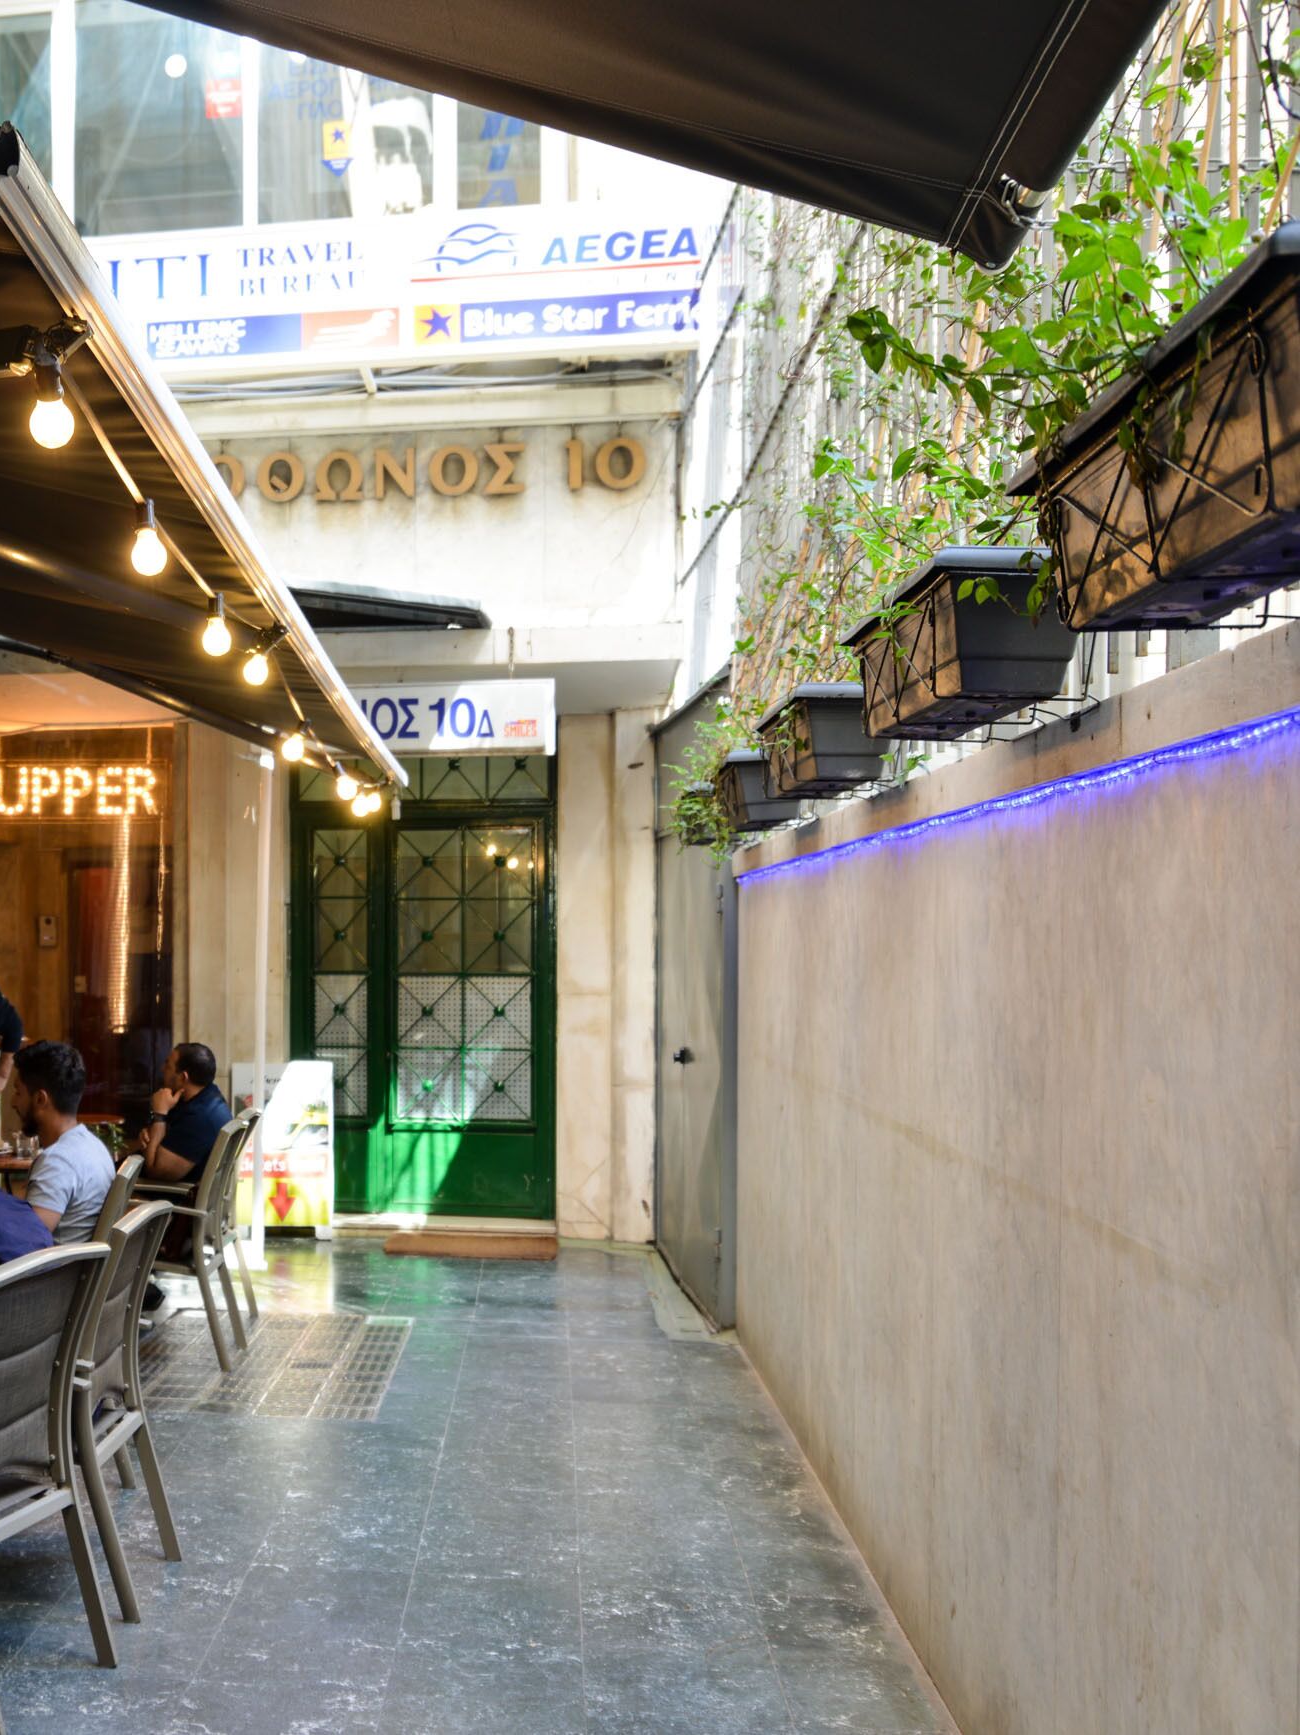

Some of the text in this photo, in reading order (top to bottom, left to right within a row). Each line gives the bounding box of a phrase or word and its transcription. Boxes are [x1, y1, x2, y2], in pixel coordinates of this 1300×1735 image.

[237, 239, 363, 268] TRAVEL
[541, 225, 714, 267] AEGEA
[239, 269, 365, 298] BUREAU
[148, 318, 247, 342] HELLENIC
[464, 307, 535, 338] Blue
[542, 301, 610, 333] Star
[155, 335, 241, 358] SEAWAYS
[566, 436, 646, 492] 10
[241, 1157, 286, 1172] ticets
